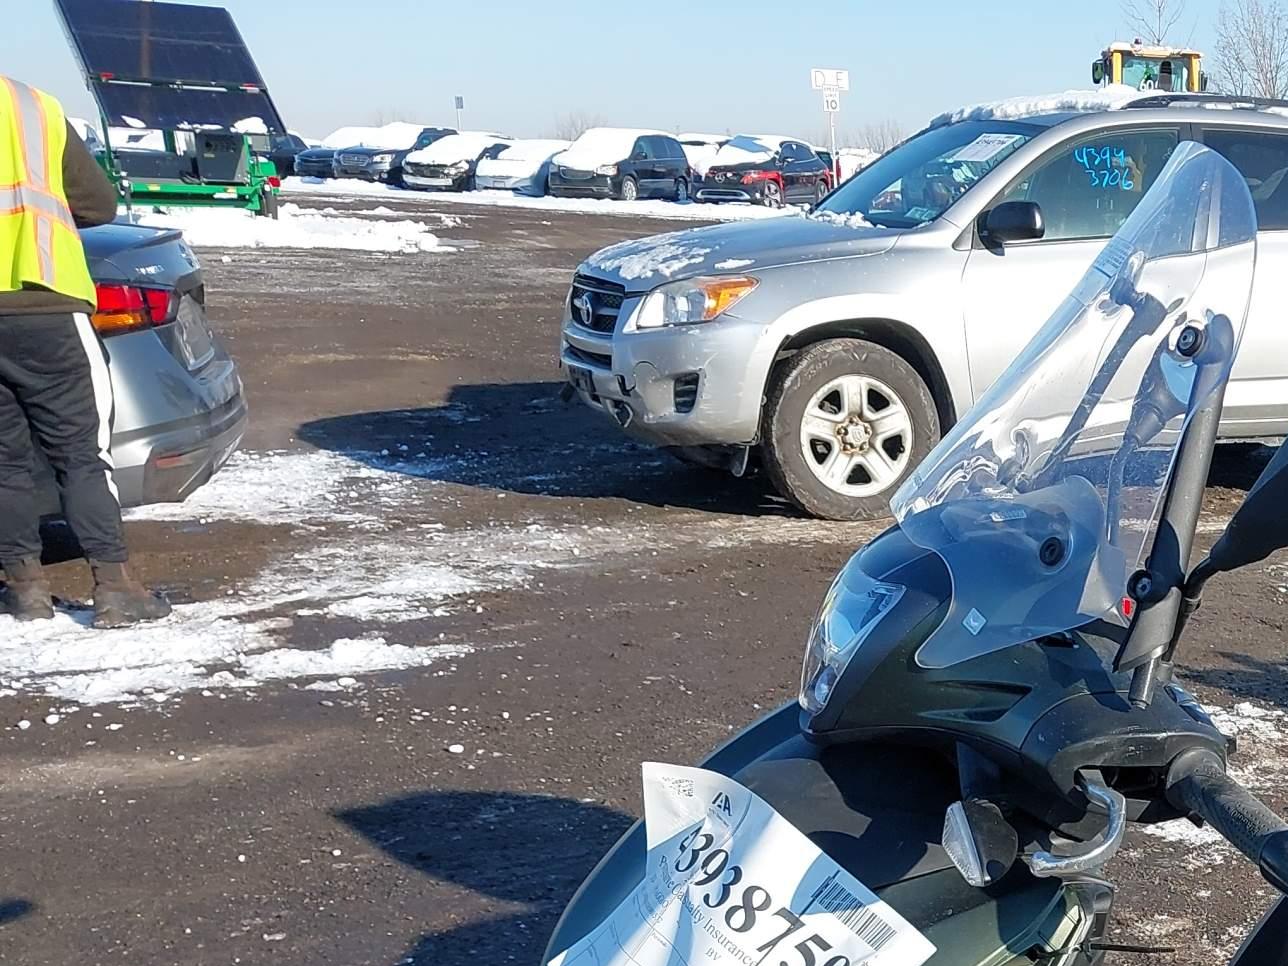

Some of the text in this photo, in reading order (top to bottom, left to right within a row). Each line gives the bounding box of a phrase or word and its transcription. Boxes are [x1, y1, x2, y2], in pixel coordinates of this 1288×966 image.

[825, 99, 838, 110] 10
[1074, 146, 1125, 169] 4394
[1085, 168, 1134, 190] 3706
